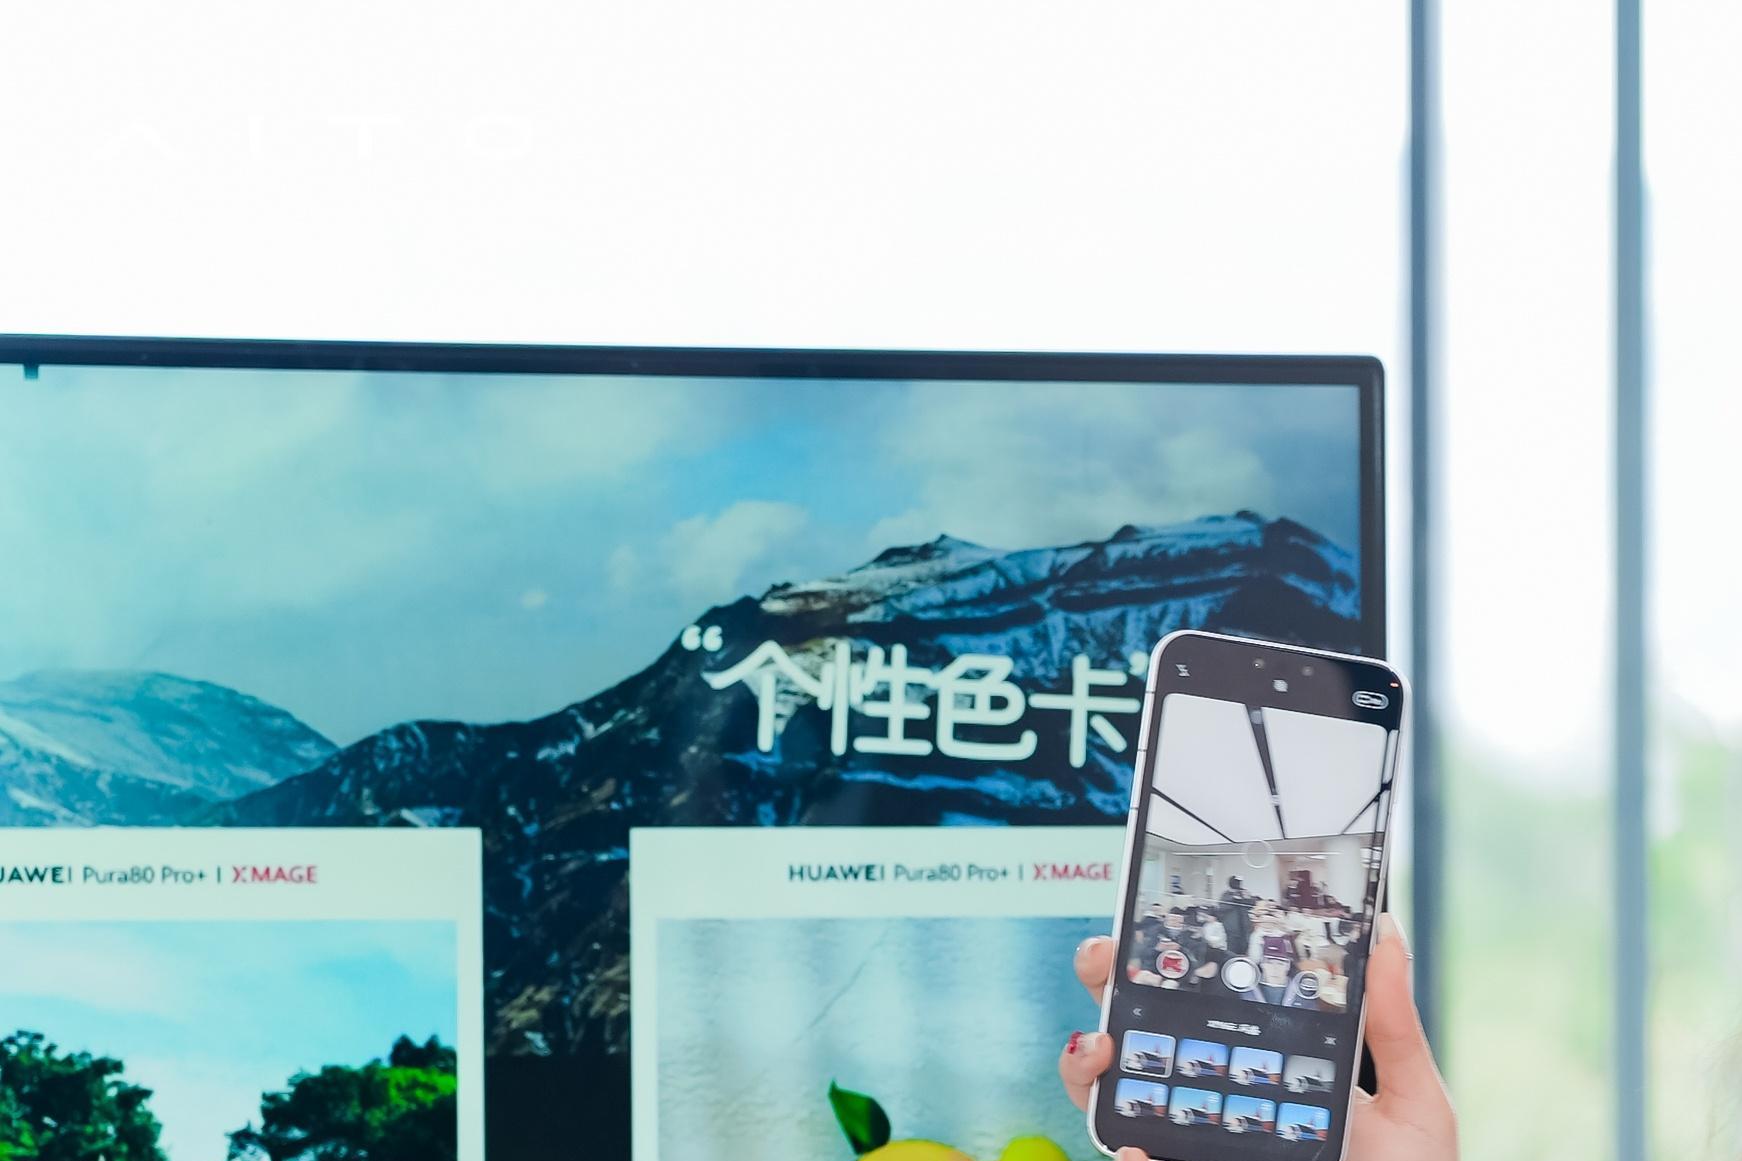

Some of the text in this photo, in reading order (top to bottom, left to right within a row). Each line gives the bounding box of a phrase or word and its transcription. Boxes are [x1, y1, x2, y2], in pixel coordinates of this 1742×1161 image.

[82, 865, 155, 884] Pura80
[161, 865, 206, 884] Pro+
[232, 865, 318, 884] XMAGE
[788, 863, 1113, 882] HUAWEI Pura80 Pro+ XMAGE
